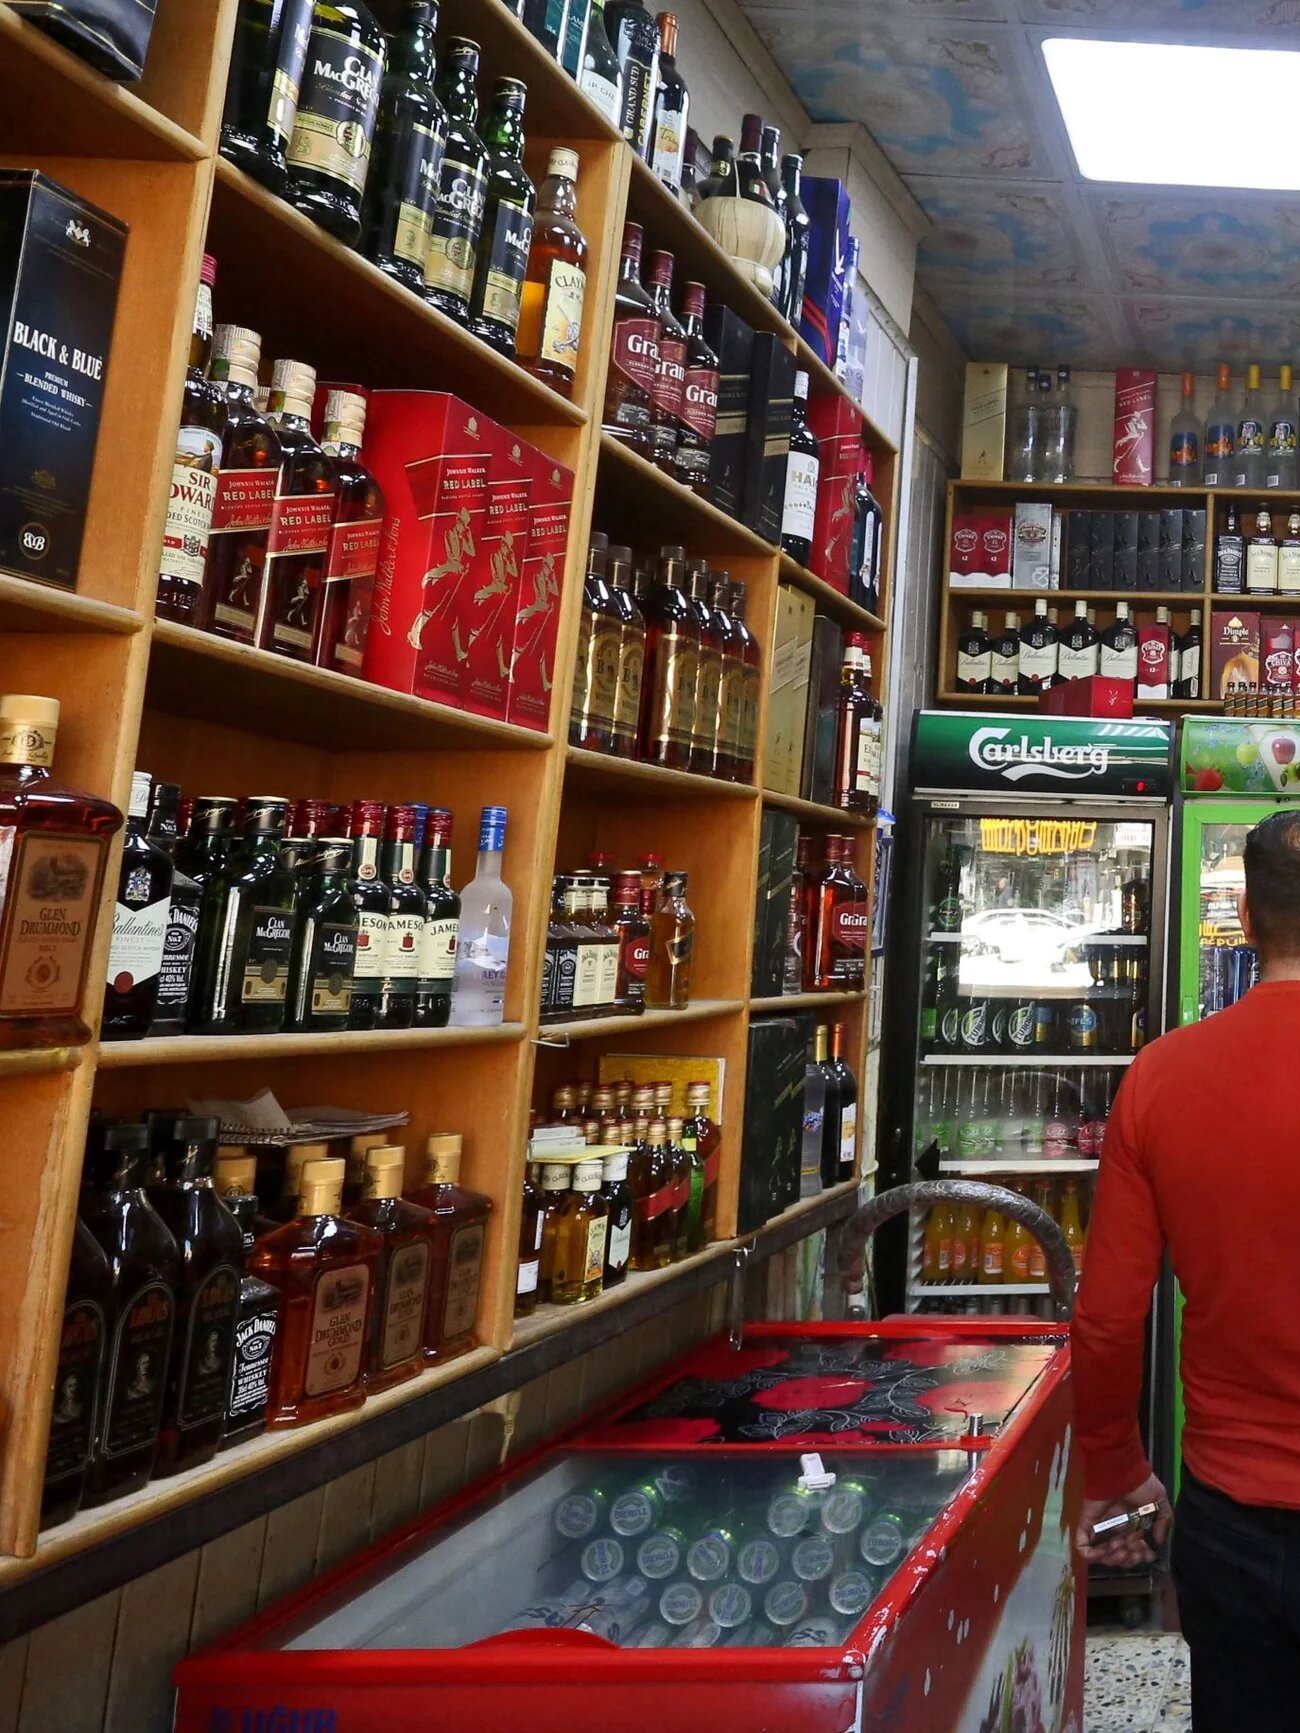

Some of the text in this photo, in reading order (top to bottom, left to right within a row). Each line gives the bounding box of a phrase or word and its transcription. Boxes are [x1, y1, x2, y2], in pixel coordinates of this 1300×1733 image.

[13, 321, 103, 382] BLACK & BLUE
[627, 334, 660, 358] Gra
[24, 373, 87, 408] BLENDED WHISKY
[189, 471, 211, 490] SIR
[443, 479, 486, 490] RED LABEL
[223, 489, 276, 501] RED LABEL
[489, 503, 527, 515] RED LABEL
[281, 513, 331, 526] RED LABEL
[1223, 626, 1249, 638] Dimple
[969, 727, 1109, 782] Carlsberg
[39, 907, 67, 922] GLEN
[19, 919, 82, 937] DRUMMOND
[161, 966, 187, 974] HISKEY
[236, 1323, 252, 1347] JACK
[237, 1369, 268, 1385] WHISKEY
